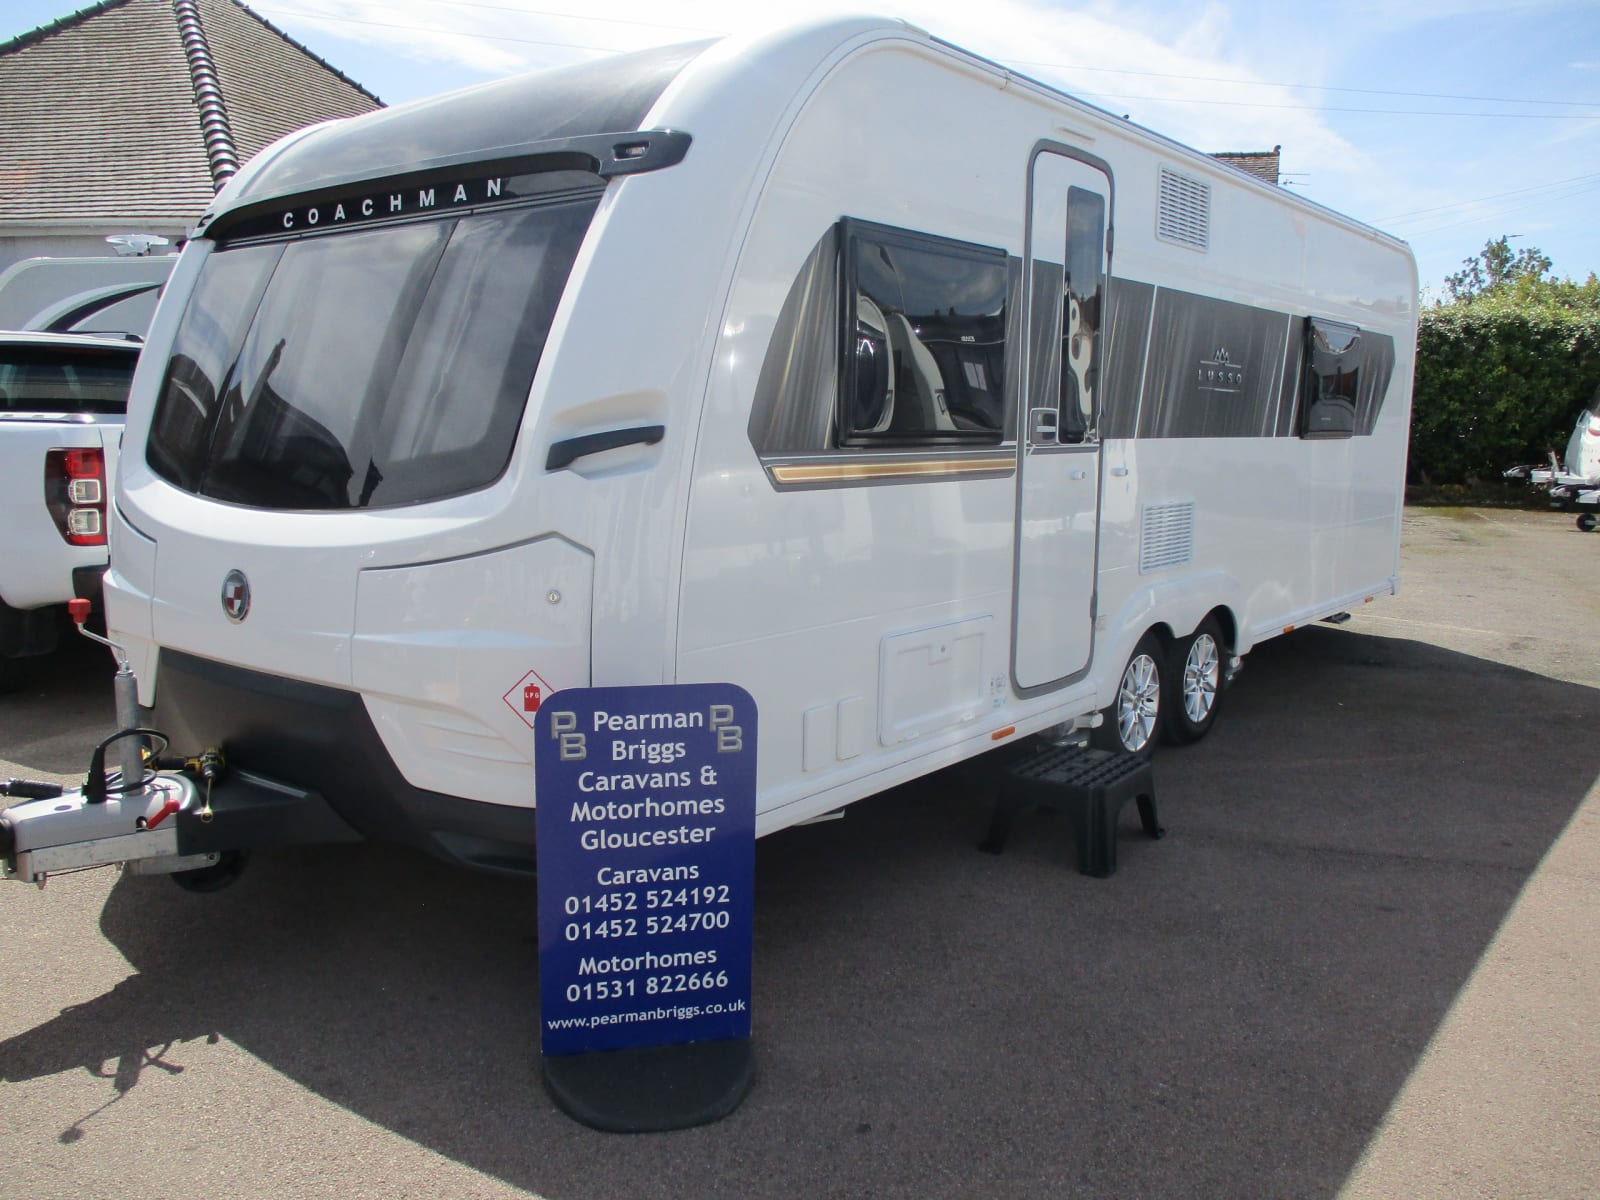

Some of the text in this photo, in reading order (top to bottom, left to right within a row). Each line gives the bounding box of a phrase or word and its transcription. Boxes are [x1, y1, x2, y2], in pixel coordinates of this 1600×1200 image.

[282, 177, 502, 229] COACHMAN
[593, 710, 703, 732] Pearman
[611, 739, 687, 764] Briggs
[578, 765, 718, 793] Caravans &
[570, 797, 726, 822] Motorhomes
[580, 825, 716, 851] Gloucester
[596, 864, 701, 886] Caravans
[564, 885, 730, 915] 01452 524192
[565, 911, 730, 942] 01452 524700
[578, 949, 718, 976] Motorhomes
[566, 969, 729, 1003] 01531 822666
[547, 999, 746, 1031] www.pearmanbriggs.co.uk
